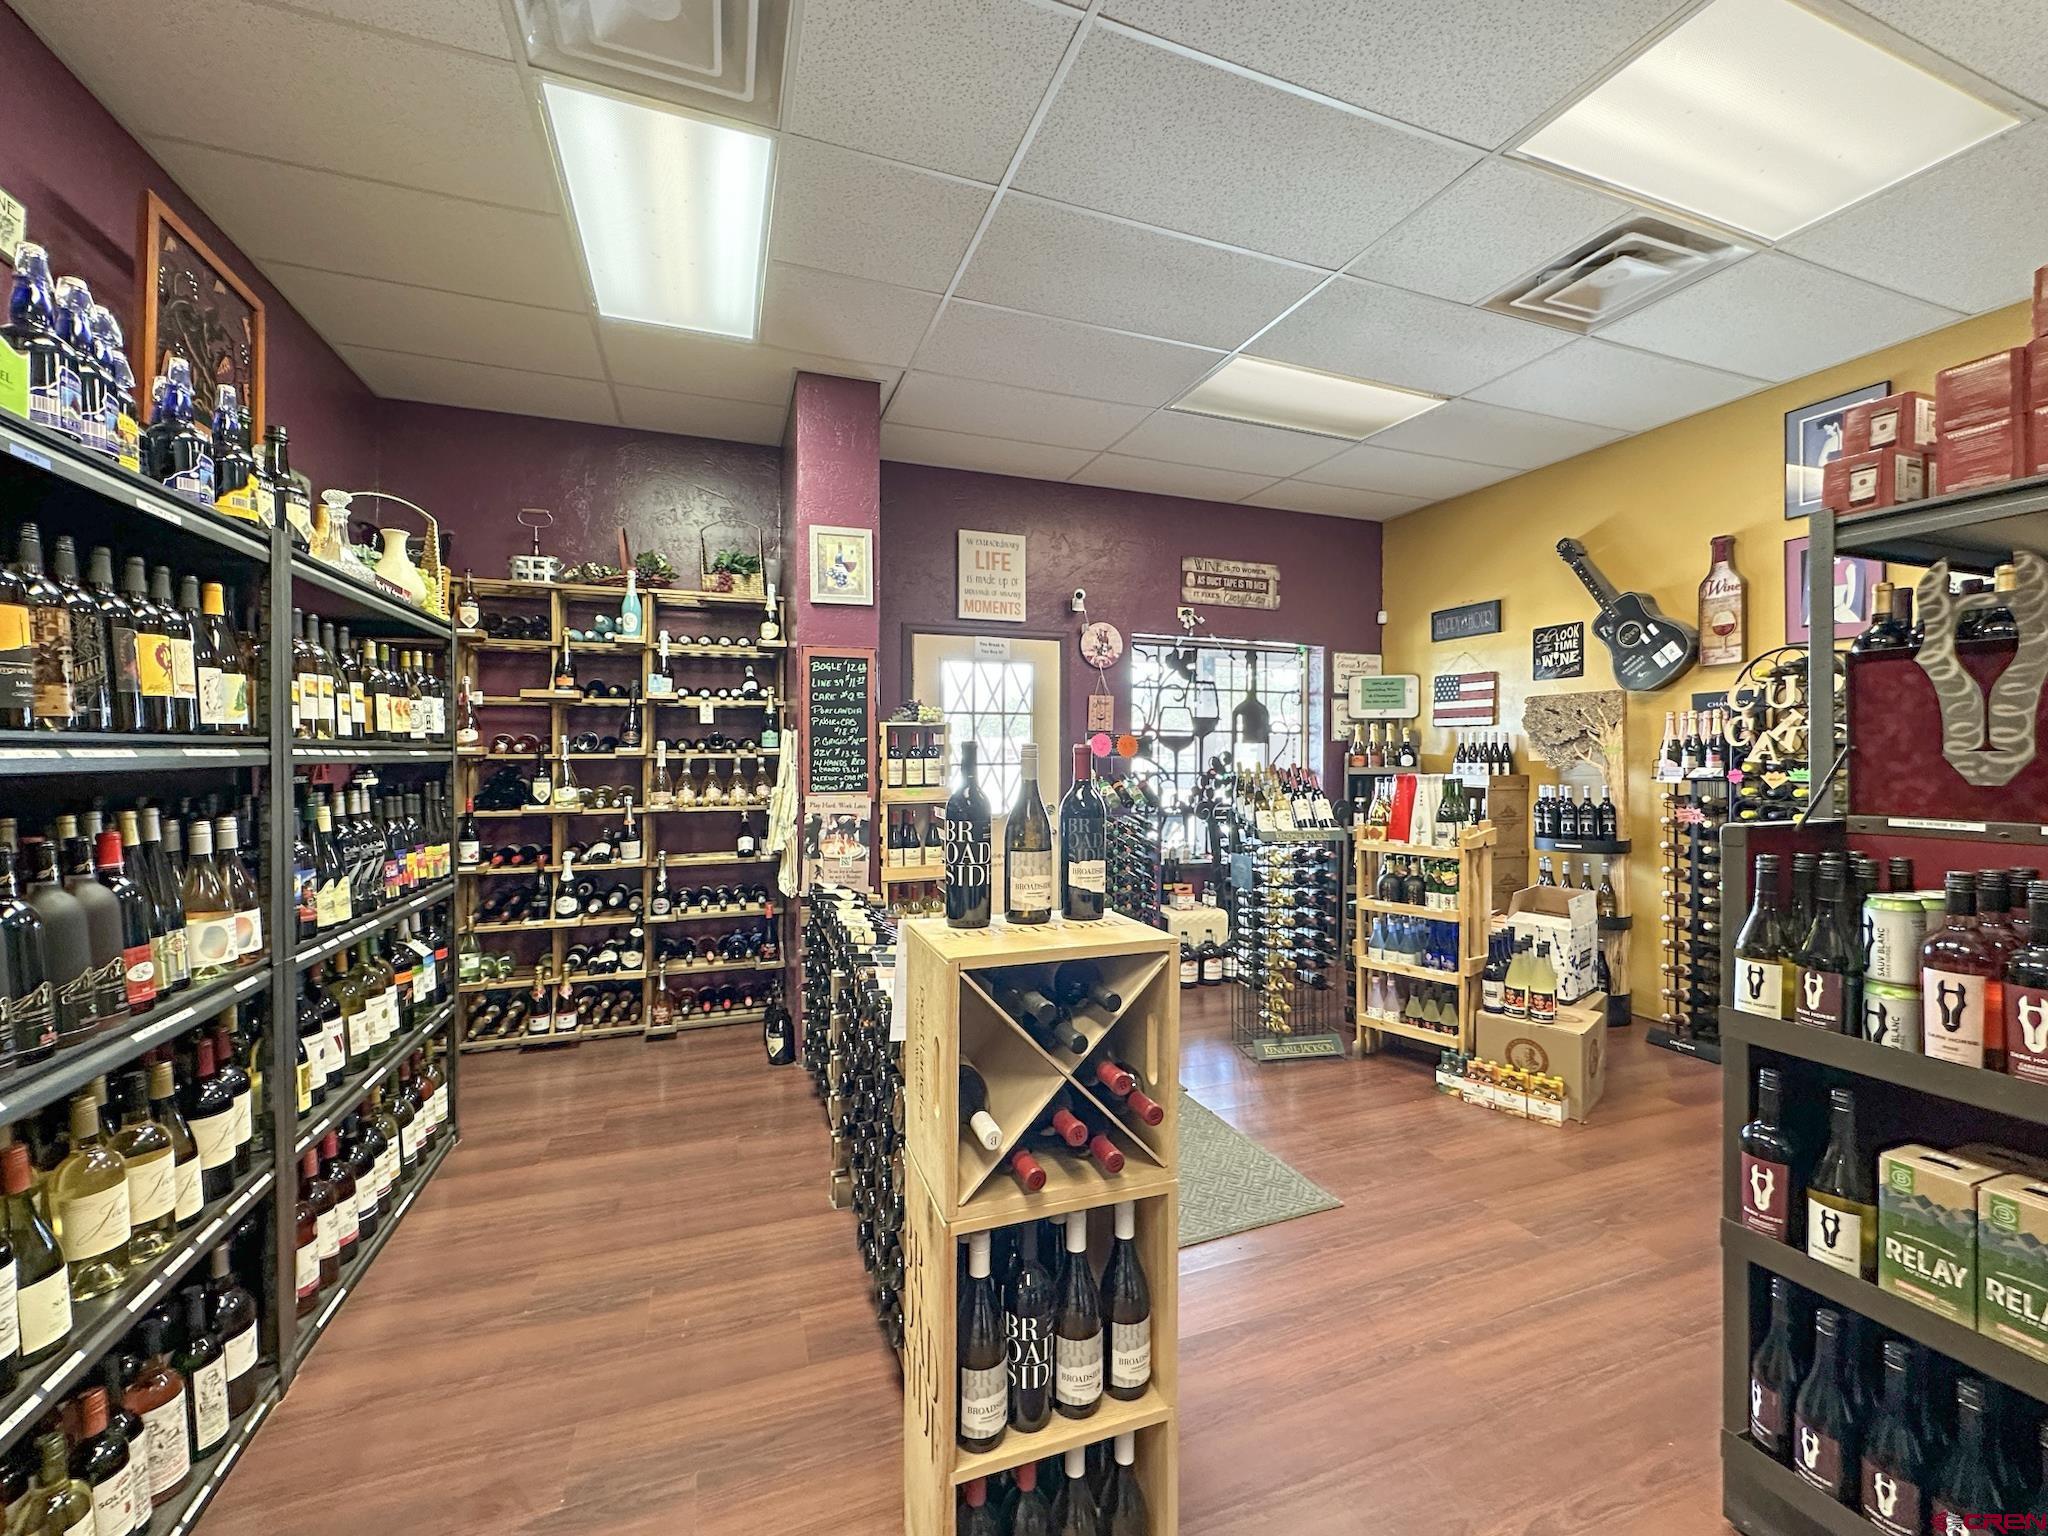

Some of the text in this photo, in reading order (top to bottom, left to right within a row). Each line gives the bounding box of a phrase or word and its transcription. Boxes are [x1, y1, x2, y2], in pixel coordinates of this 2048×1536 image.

[975, 550, 1012, 572] LIFE
[1193, 557, 1222, 574] WINE
[1242, 567, 1267, 575] WOMEN
[1196, 575, 1205, 585] AS
[1206, 576, 1222, 587] DUCT
[1223, 577, 1237, 589] TAPE
[1238, 579, 1245, 588] IS
[1246, 580, 1253, 590] TO
[1704, 578, 1742, 597] Wine
[1201, 592, 1220, 600] FIXES
[963, 599, 1022, 616] MOMENTS
[1555, 623, 1580, 642] LOOK
[1554, 638, 1579, 652] TIME
[811, 661, 842, 673] BOGLE
[811, 678, 832, 688] LINE
[833, 679, 844, 687] 39
[1707, 698, 1749, 709] CHANON
[812, 757, 867, 768] 14 HANDS RED
[946, 820, 975, 843] BR
[1068, 818, 1091, 833] BR
[946, 842, 991, 865] OAD
[1877, 927, 1886, 955] BLANC
[1877, 957, 1886, 977] SAUV
[1810, 1011, 1837, 1021] HORSE
[1891, 1016, 1901, 1044] BLANC
[1948, 1037, 1980, 1047] HORSE
[2009, 1050, 2032, 1062] DARK
[1885, 1236, 1969, 1289] RELAY
[1004, 1310, 1040, 1341] BR
[1005, 1332, 1054, 1365] OAD
